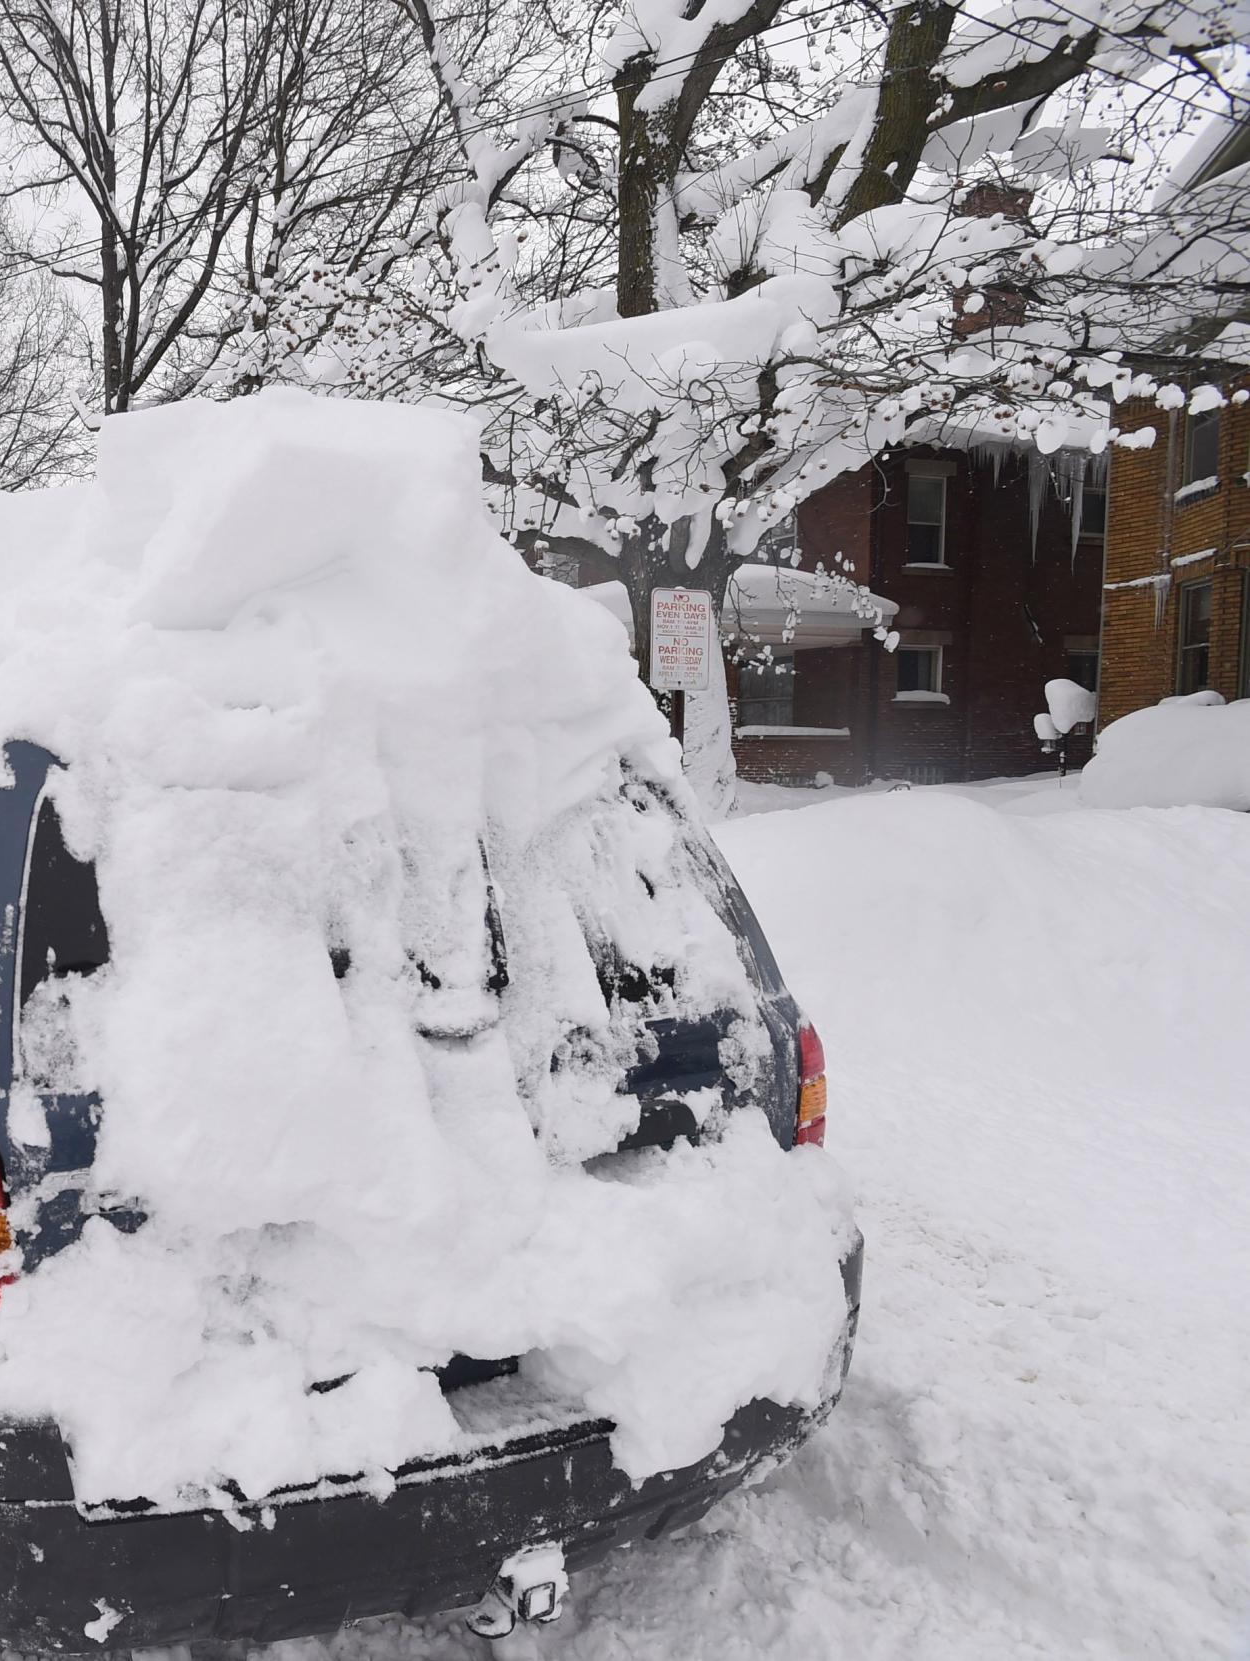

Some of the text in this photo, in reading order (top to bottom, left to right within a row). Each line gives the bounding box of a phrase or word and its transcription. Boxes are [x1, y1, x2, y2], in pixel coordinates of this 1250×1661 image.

[673, 594, 690, 603] NO
[657, 602, 706, 612] PARKING
[656, 611, 707, 620] EVEN DAYS
[673, 637, 689, 646] NO
[658, 645, 704, 656] PARKING
[659, 655, 702, 665] WEDNESDAY
